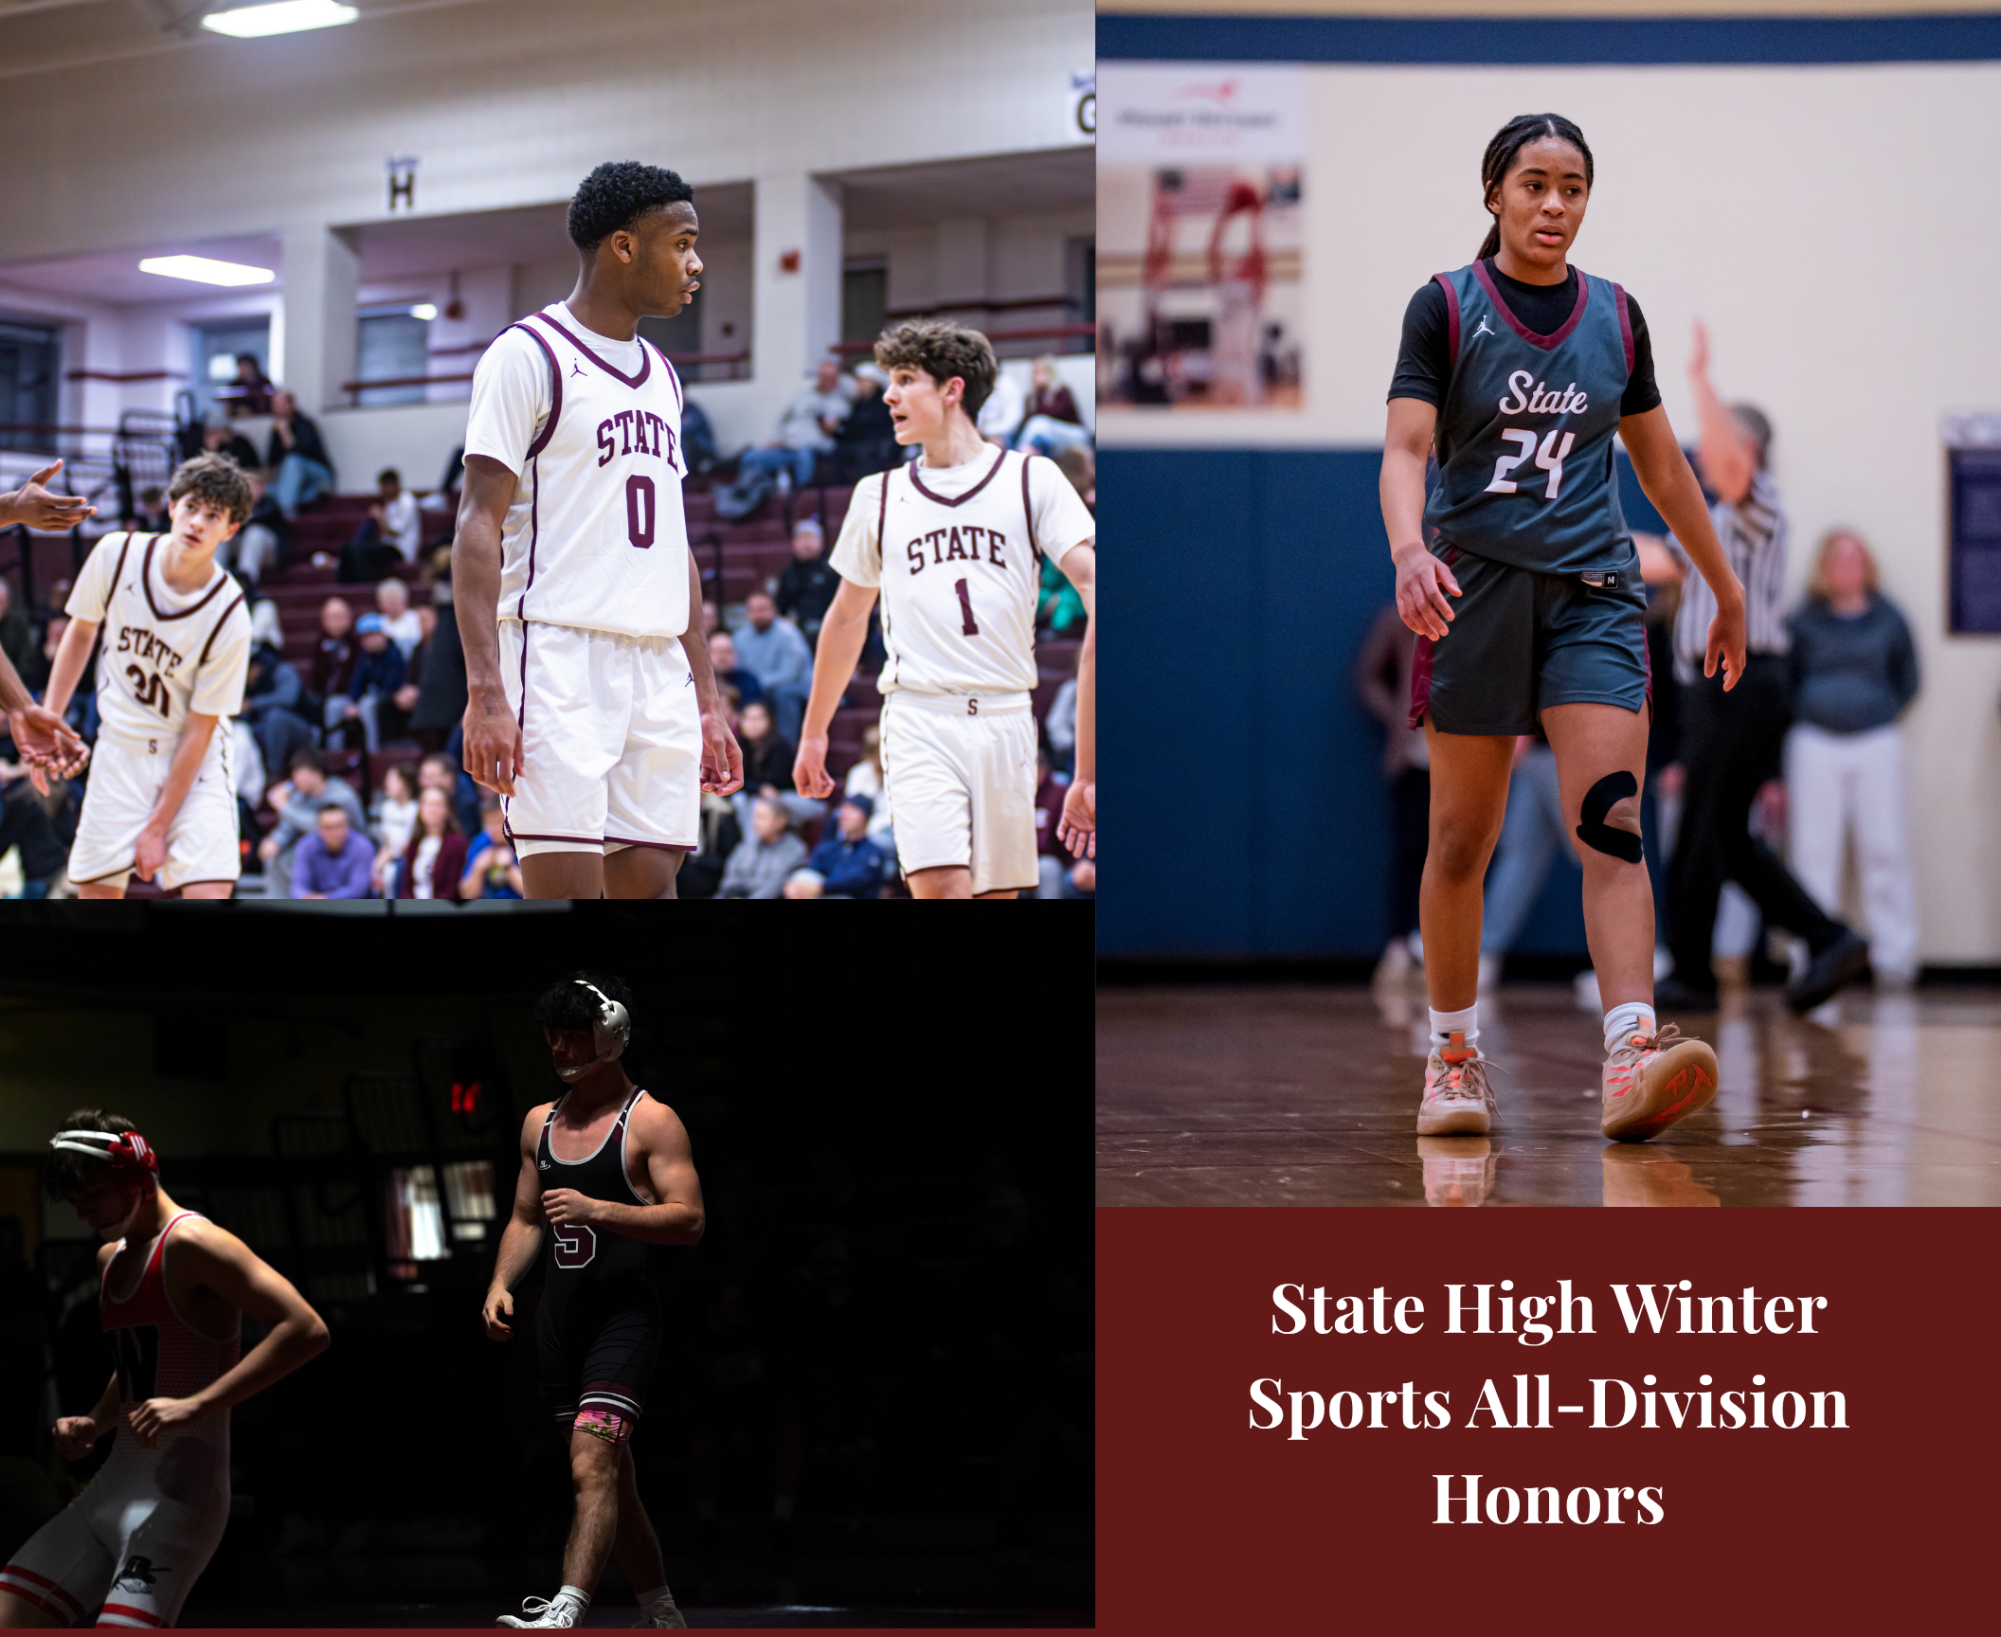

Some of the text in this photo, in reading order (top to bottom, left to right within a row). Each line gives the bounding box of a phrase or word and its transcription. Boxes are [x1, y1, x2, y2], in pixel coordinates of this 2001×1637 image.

[389, 172, 414, 210] H
[1499, 369, 1588, 415] State
[597, 409, 680, 475] STATE
[1483, 428, 1576, 499] 24
[625, 474, 656, 549] 0
[906, 525, 1007, 576] STATE
[1607, 575, 1615, 585] M
[954, 578, 979, 637] 1
[117, 626, 182, 678] STATE
[967, 698, 978, 716] S
[148, 739, 158, 755] S
